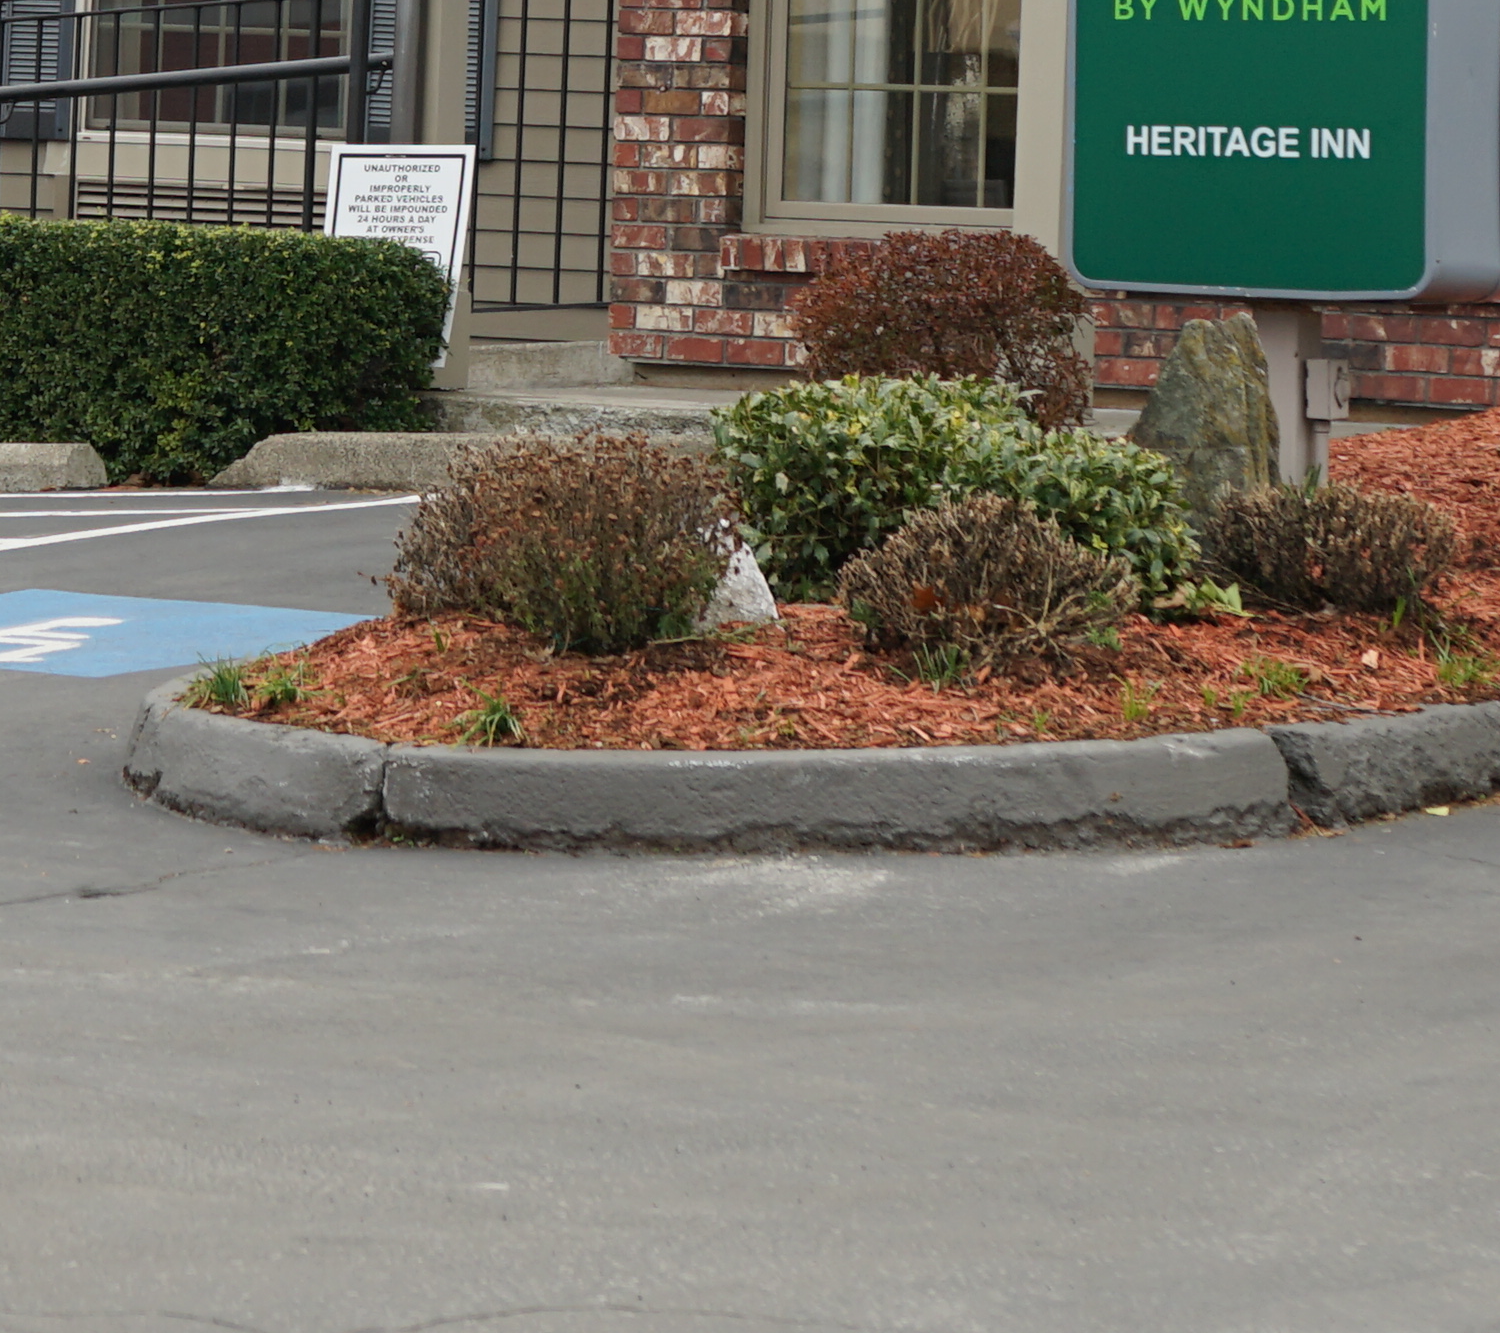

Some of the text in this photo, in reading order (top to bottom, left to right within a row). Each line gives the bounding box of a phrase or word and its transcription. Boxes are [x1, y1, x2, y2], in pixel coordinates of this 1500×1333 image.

[1126, 125, 1371, 160] HERITAGE INN
[369, 185, 431, 193] IMPROPERLY
[354, 195, 444, 203] PARKED VEHICLES
[348, 205, 448, 213] WILL BE IMPOUNDED
[357, 215, 369, 223] 24
[371, 215, 405, 223] HOURS
[418, 215, 436, 223] DAY
[366, 225, 424, 234] AT OWNER'S
